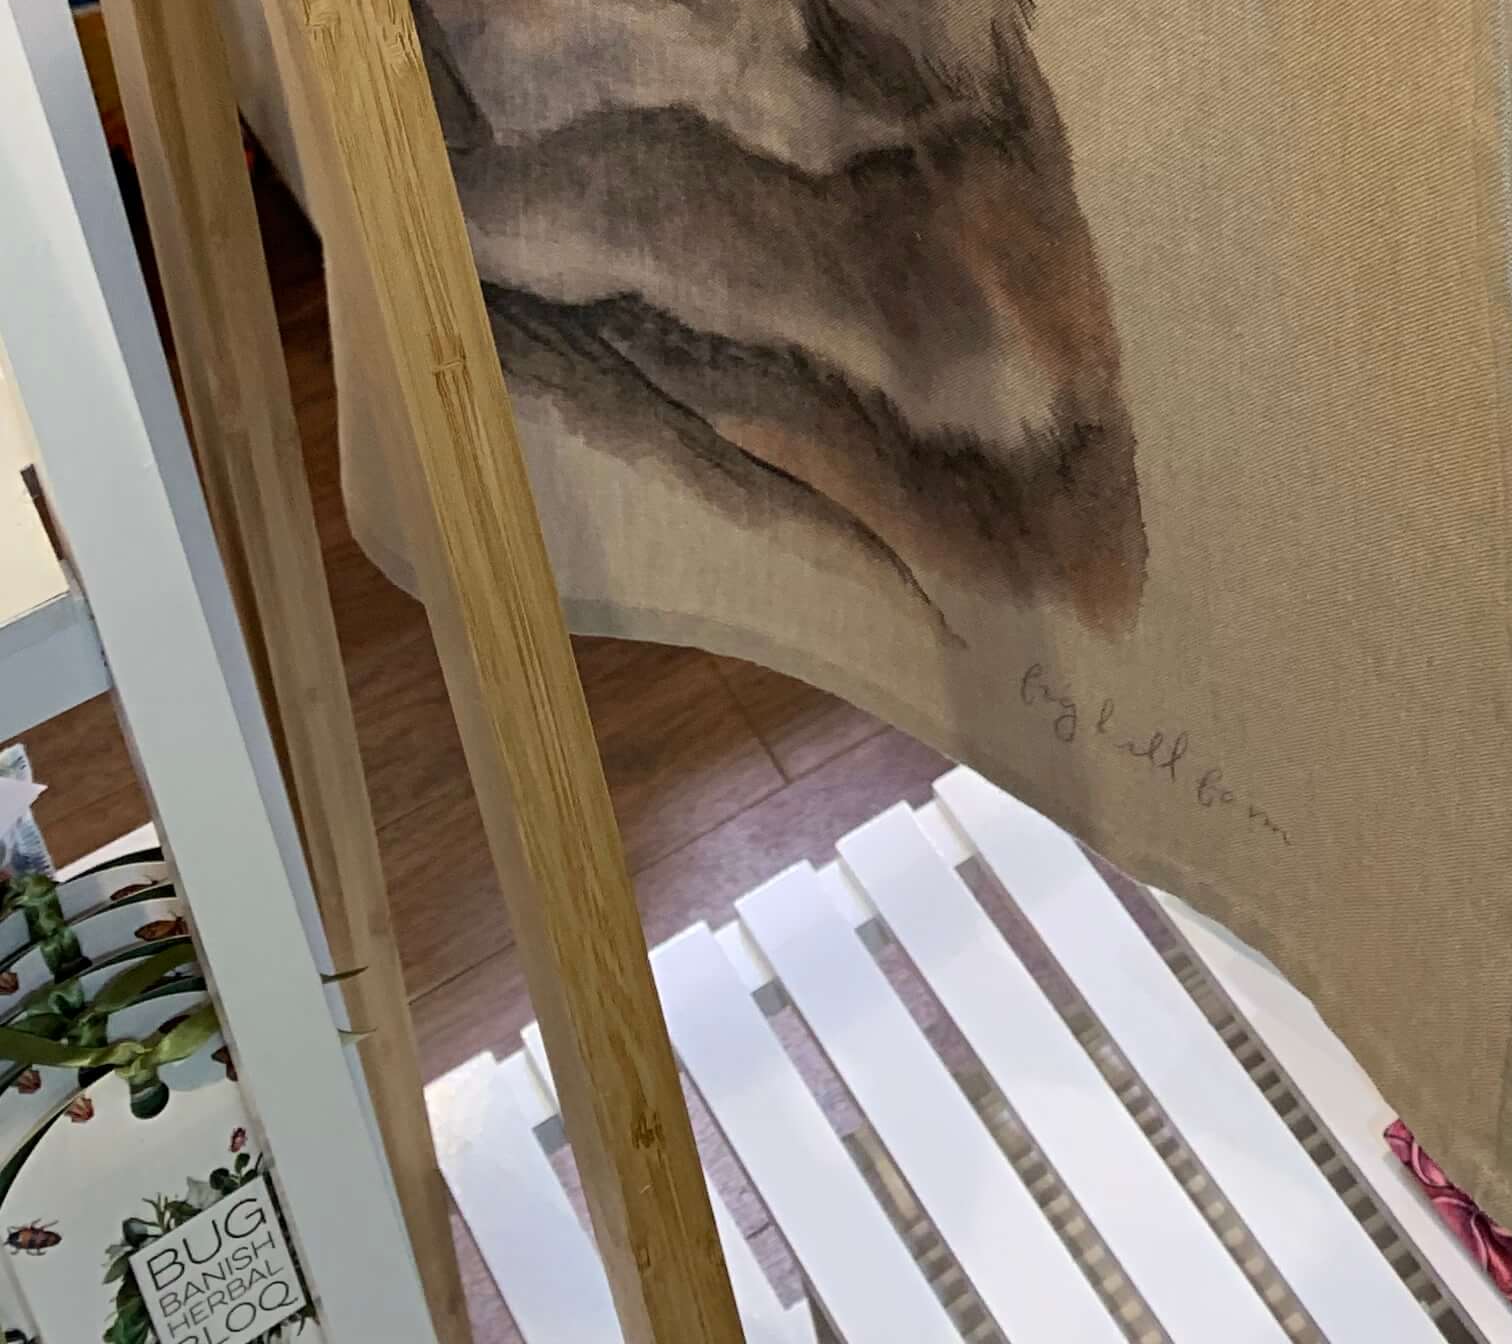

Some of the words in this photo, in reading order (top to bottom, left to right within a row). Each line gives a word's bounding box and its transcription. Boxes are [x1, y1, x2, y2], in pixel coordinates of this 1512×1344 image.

[147, 1197, 267, 1292] BUG
[159, 1230, 276, 1318] BANISH
[167, 1259, 285, 1339] HERBAL
